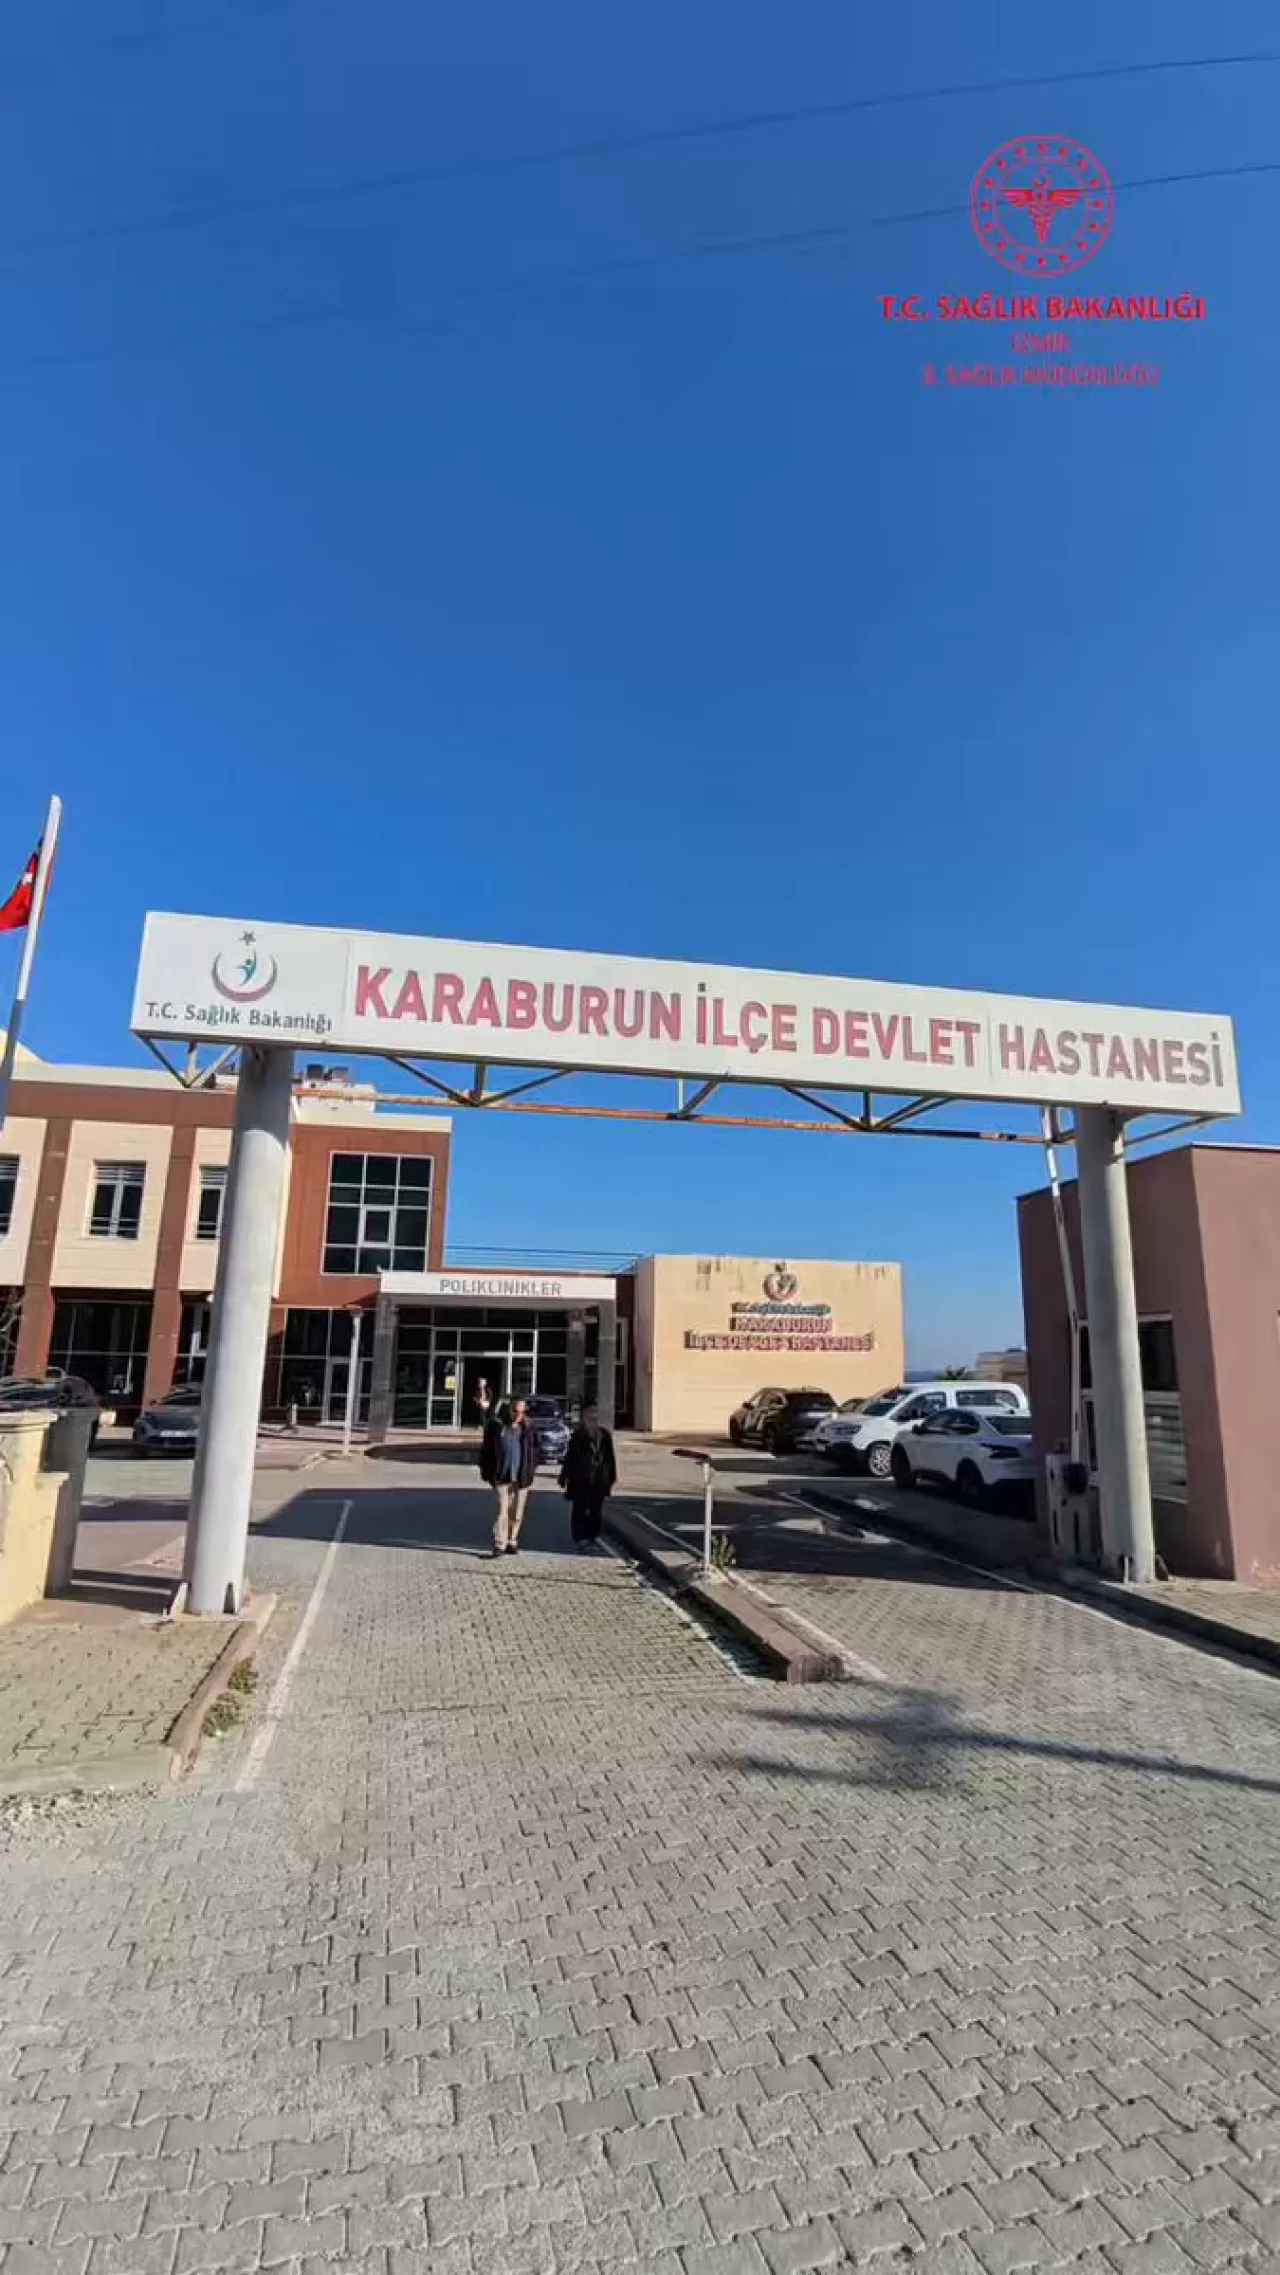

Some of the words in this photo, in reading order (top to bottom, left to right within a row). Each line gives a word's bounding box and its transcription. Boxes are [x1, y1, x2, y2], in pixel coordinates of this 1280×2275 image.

[145, 1002, 177, 1019] T.C.
[184, 1003, 240, 1027] Sağlık
[249, 1009, 333, 1034] Bakanlığı
[354, 965, 682, 1042] KARABURUN
[696, 982, 798, 1054] İLÇE
[811, 1006, 982, 1068] DEVLET
[997, 1022, 1226, 1088] HASTANESİ
